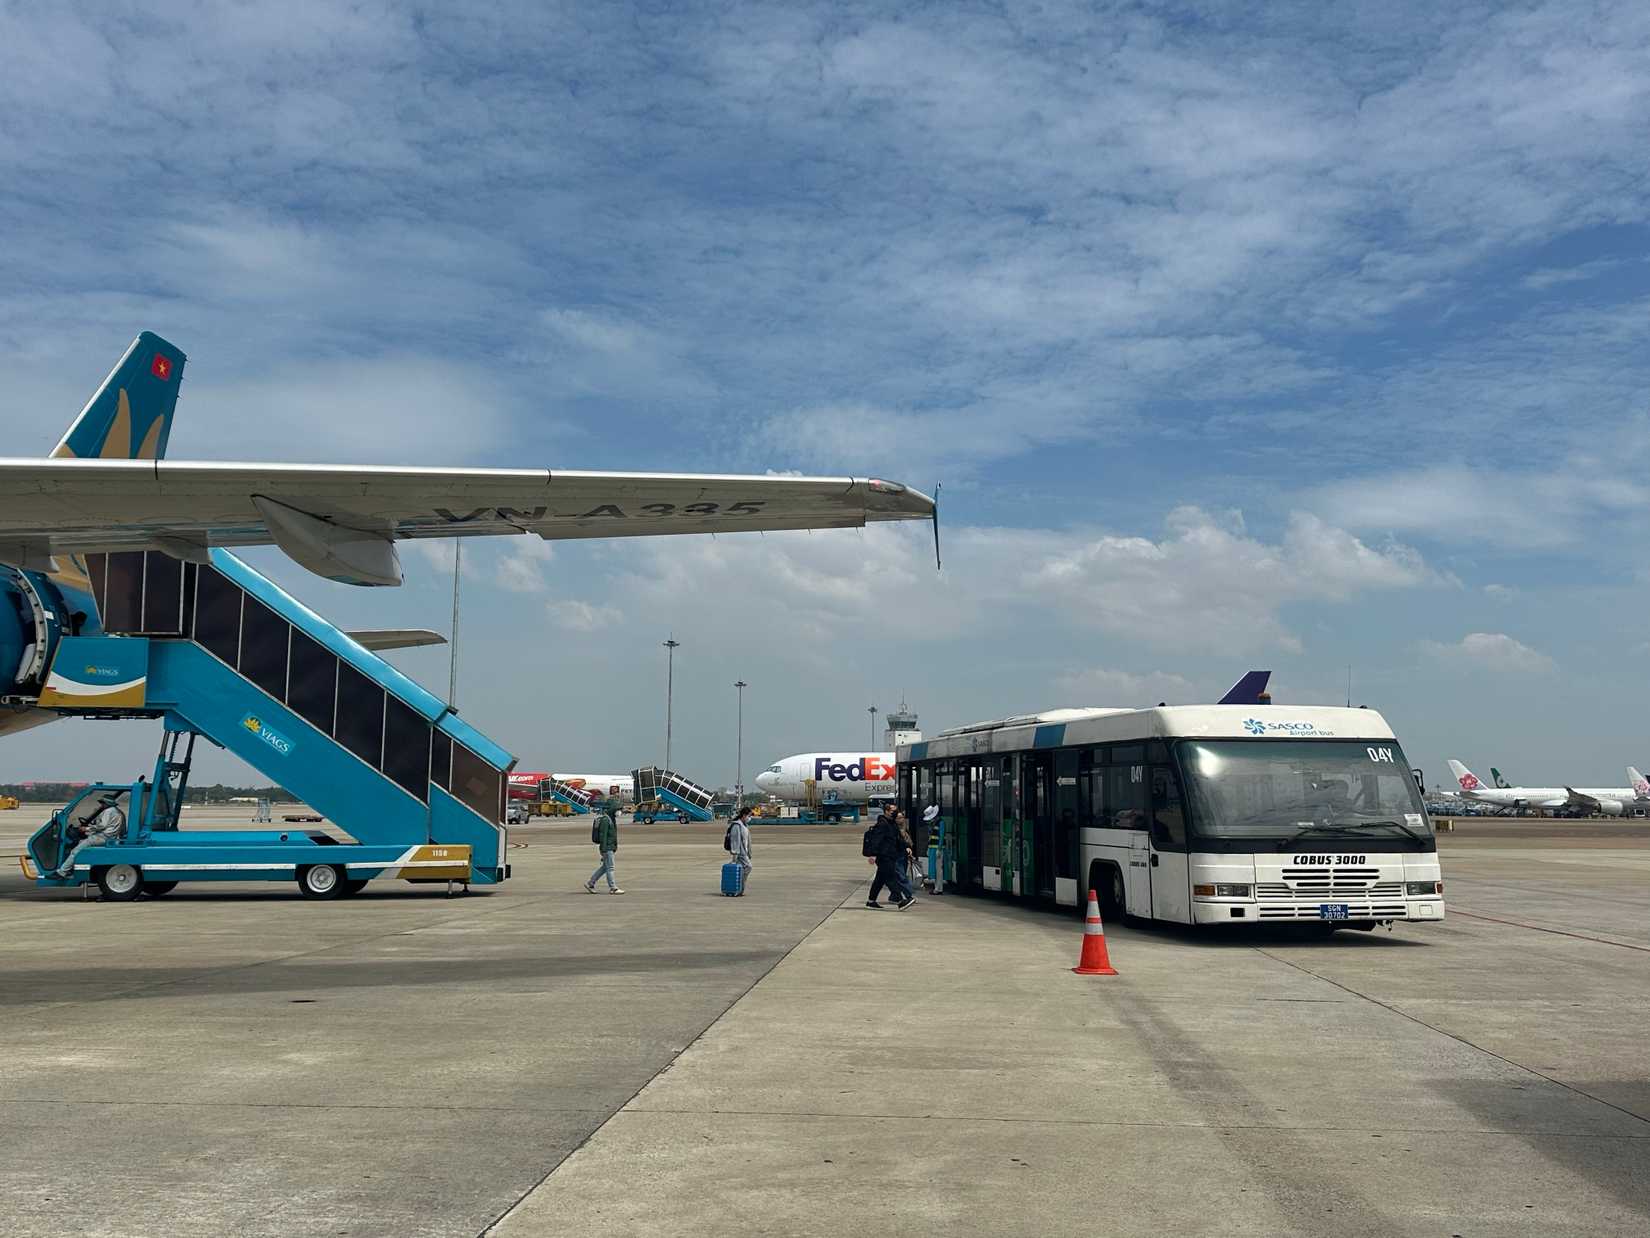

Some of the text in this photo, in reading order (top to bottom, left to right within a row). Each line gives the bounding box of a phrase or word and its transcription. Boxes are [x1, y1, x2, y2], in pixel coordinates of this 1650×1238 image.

[262, 728, 290, 752] VIAGS
[1366, 747, 1394, 763] 04Y
[815, 757, 896, 782] FedEx
[1130, 765, 1143, 783] 04Y
[1293, 855, 1366, 865] COBUS 3000
